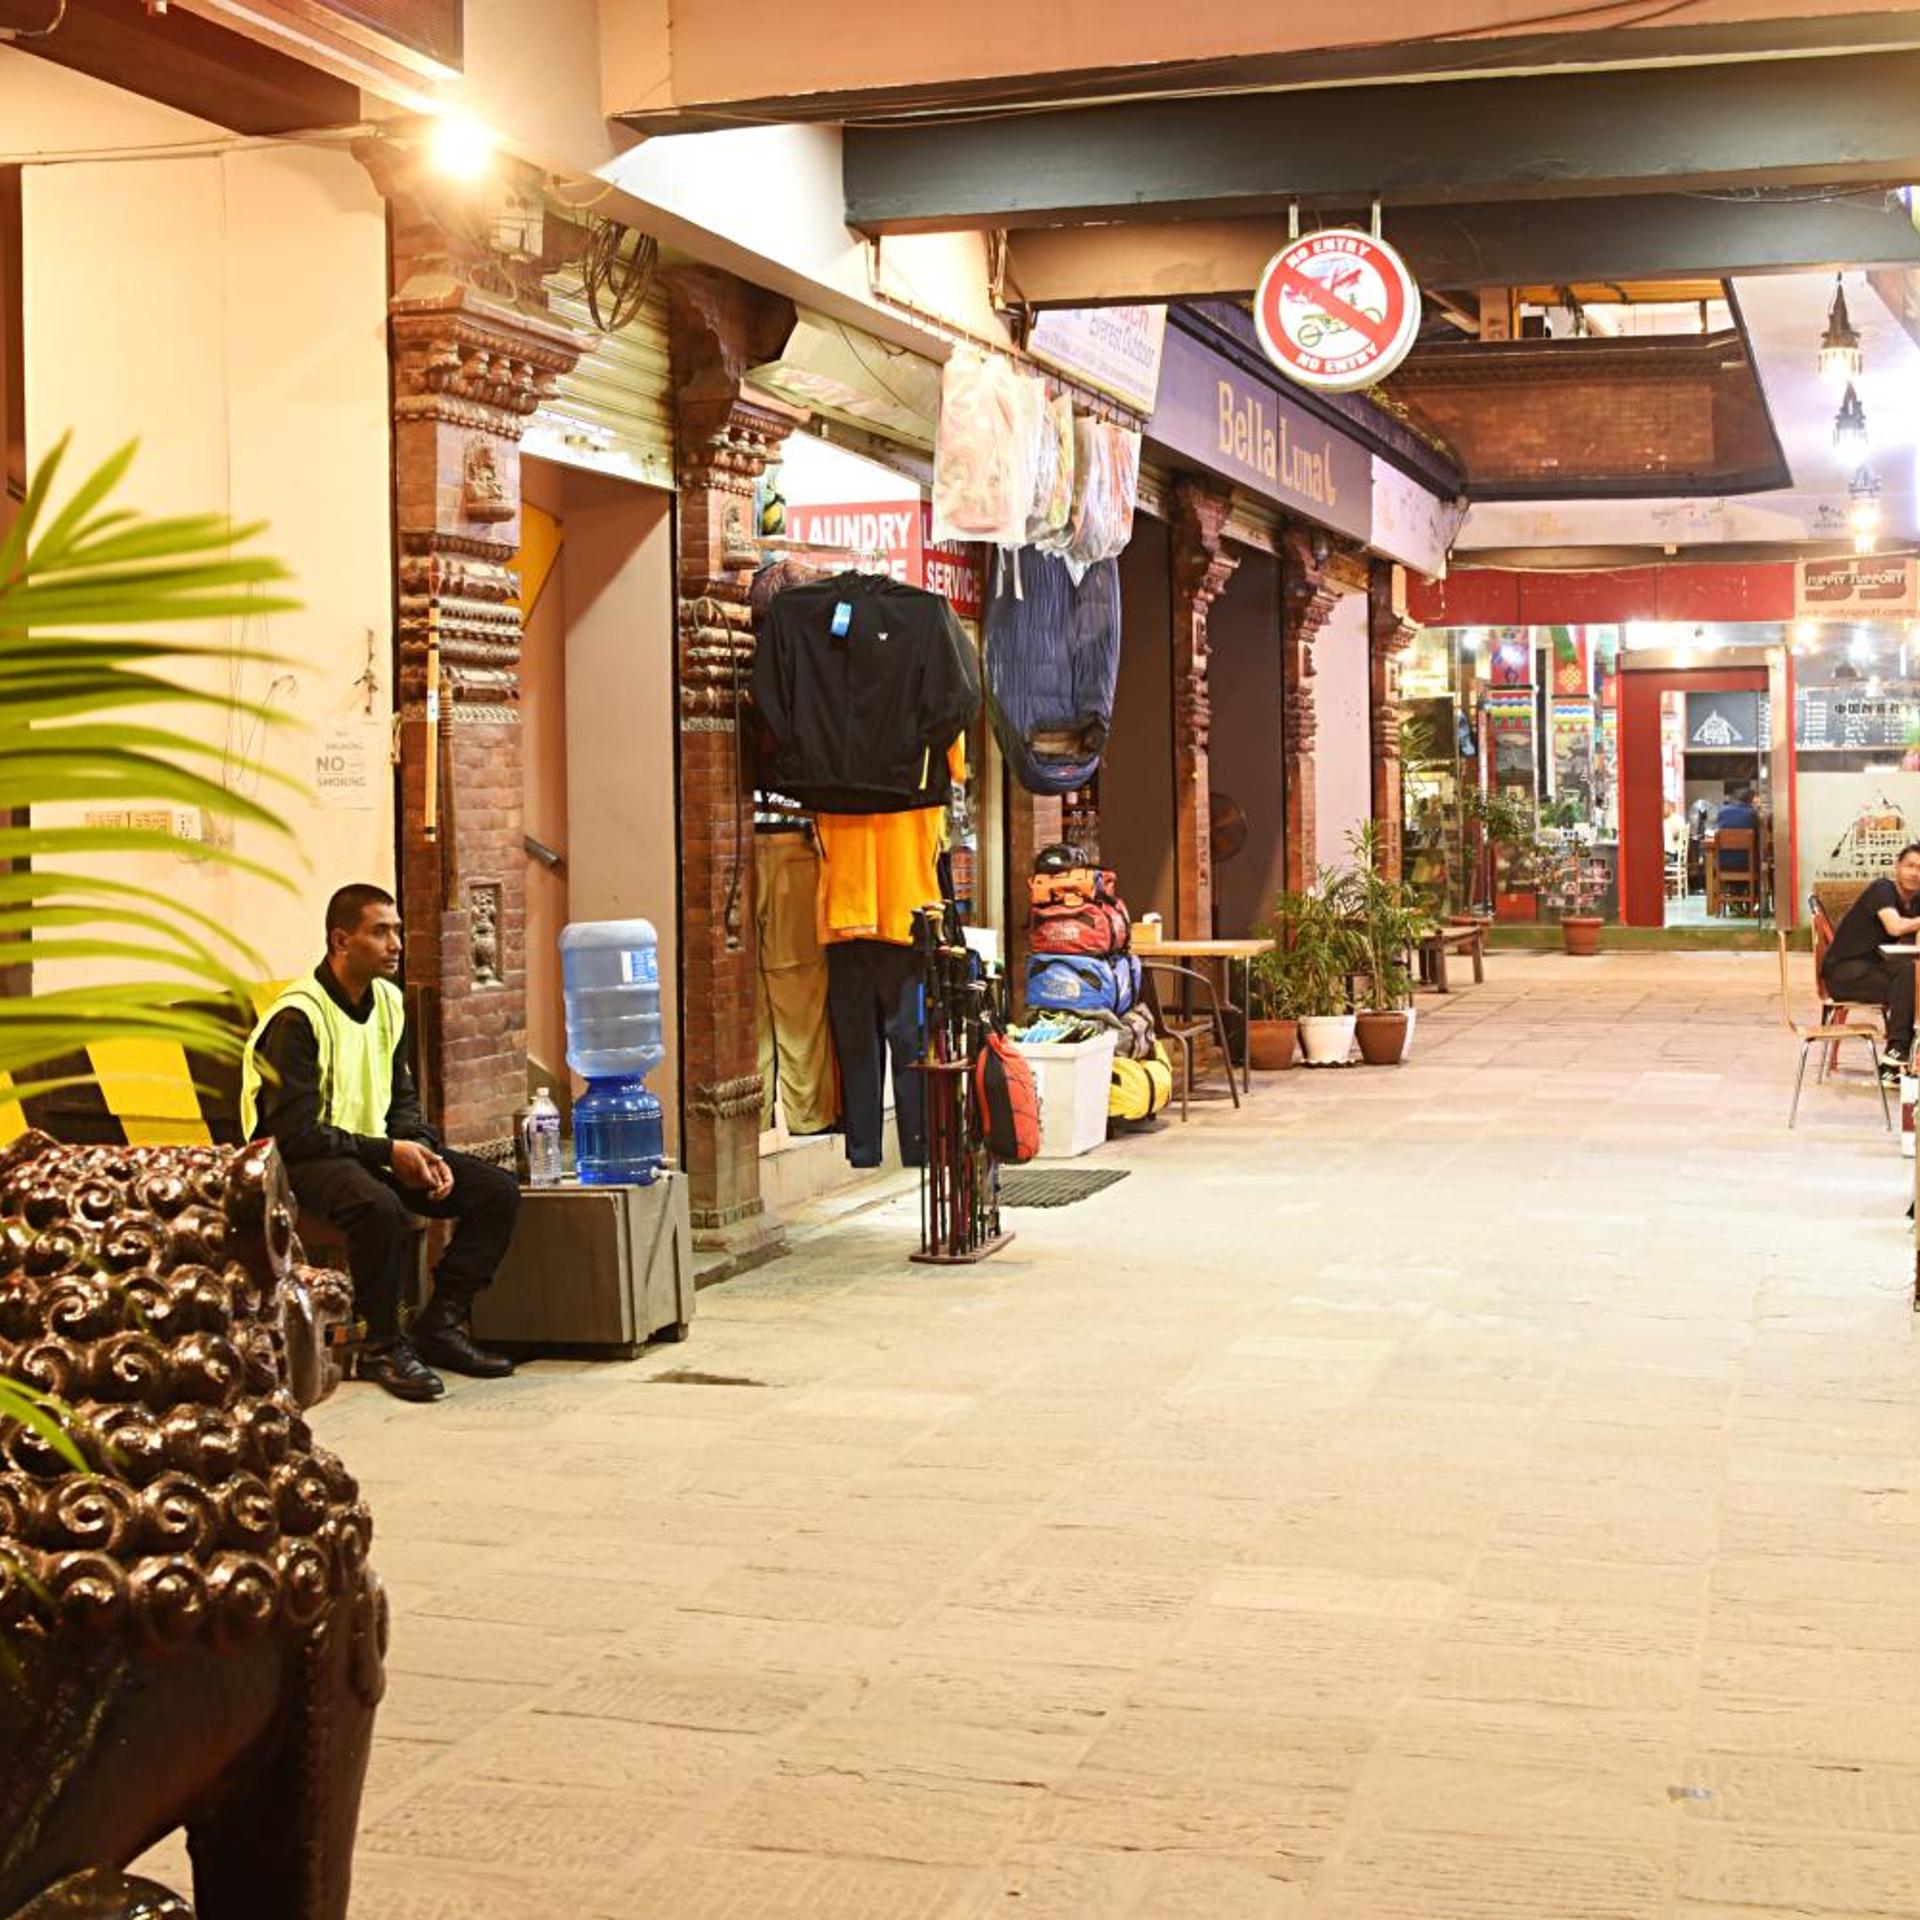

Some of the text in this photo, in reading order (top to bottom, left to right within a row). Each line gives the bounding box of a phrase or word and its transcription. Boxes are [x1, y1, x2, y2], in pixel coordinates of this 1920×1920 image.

[1285, 238, 1371, 268] NO ENTRY
[1296, 342, 1378, 373] NO ENTRY
[1218, 380, 1324, 501] Bella Luna
[316, 756, 345, 772] NO
